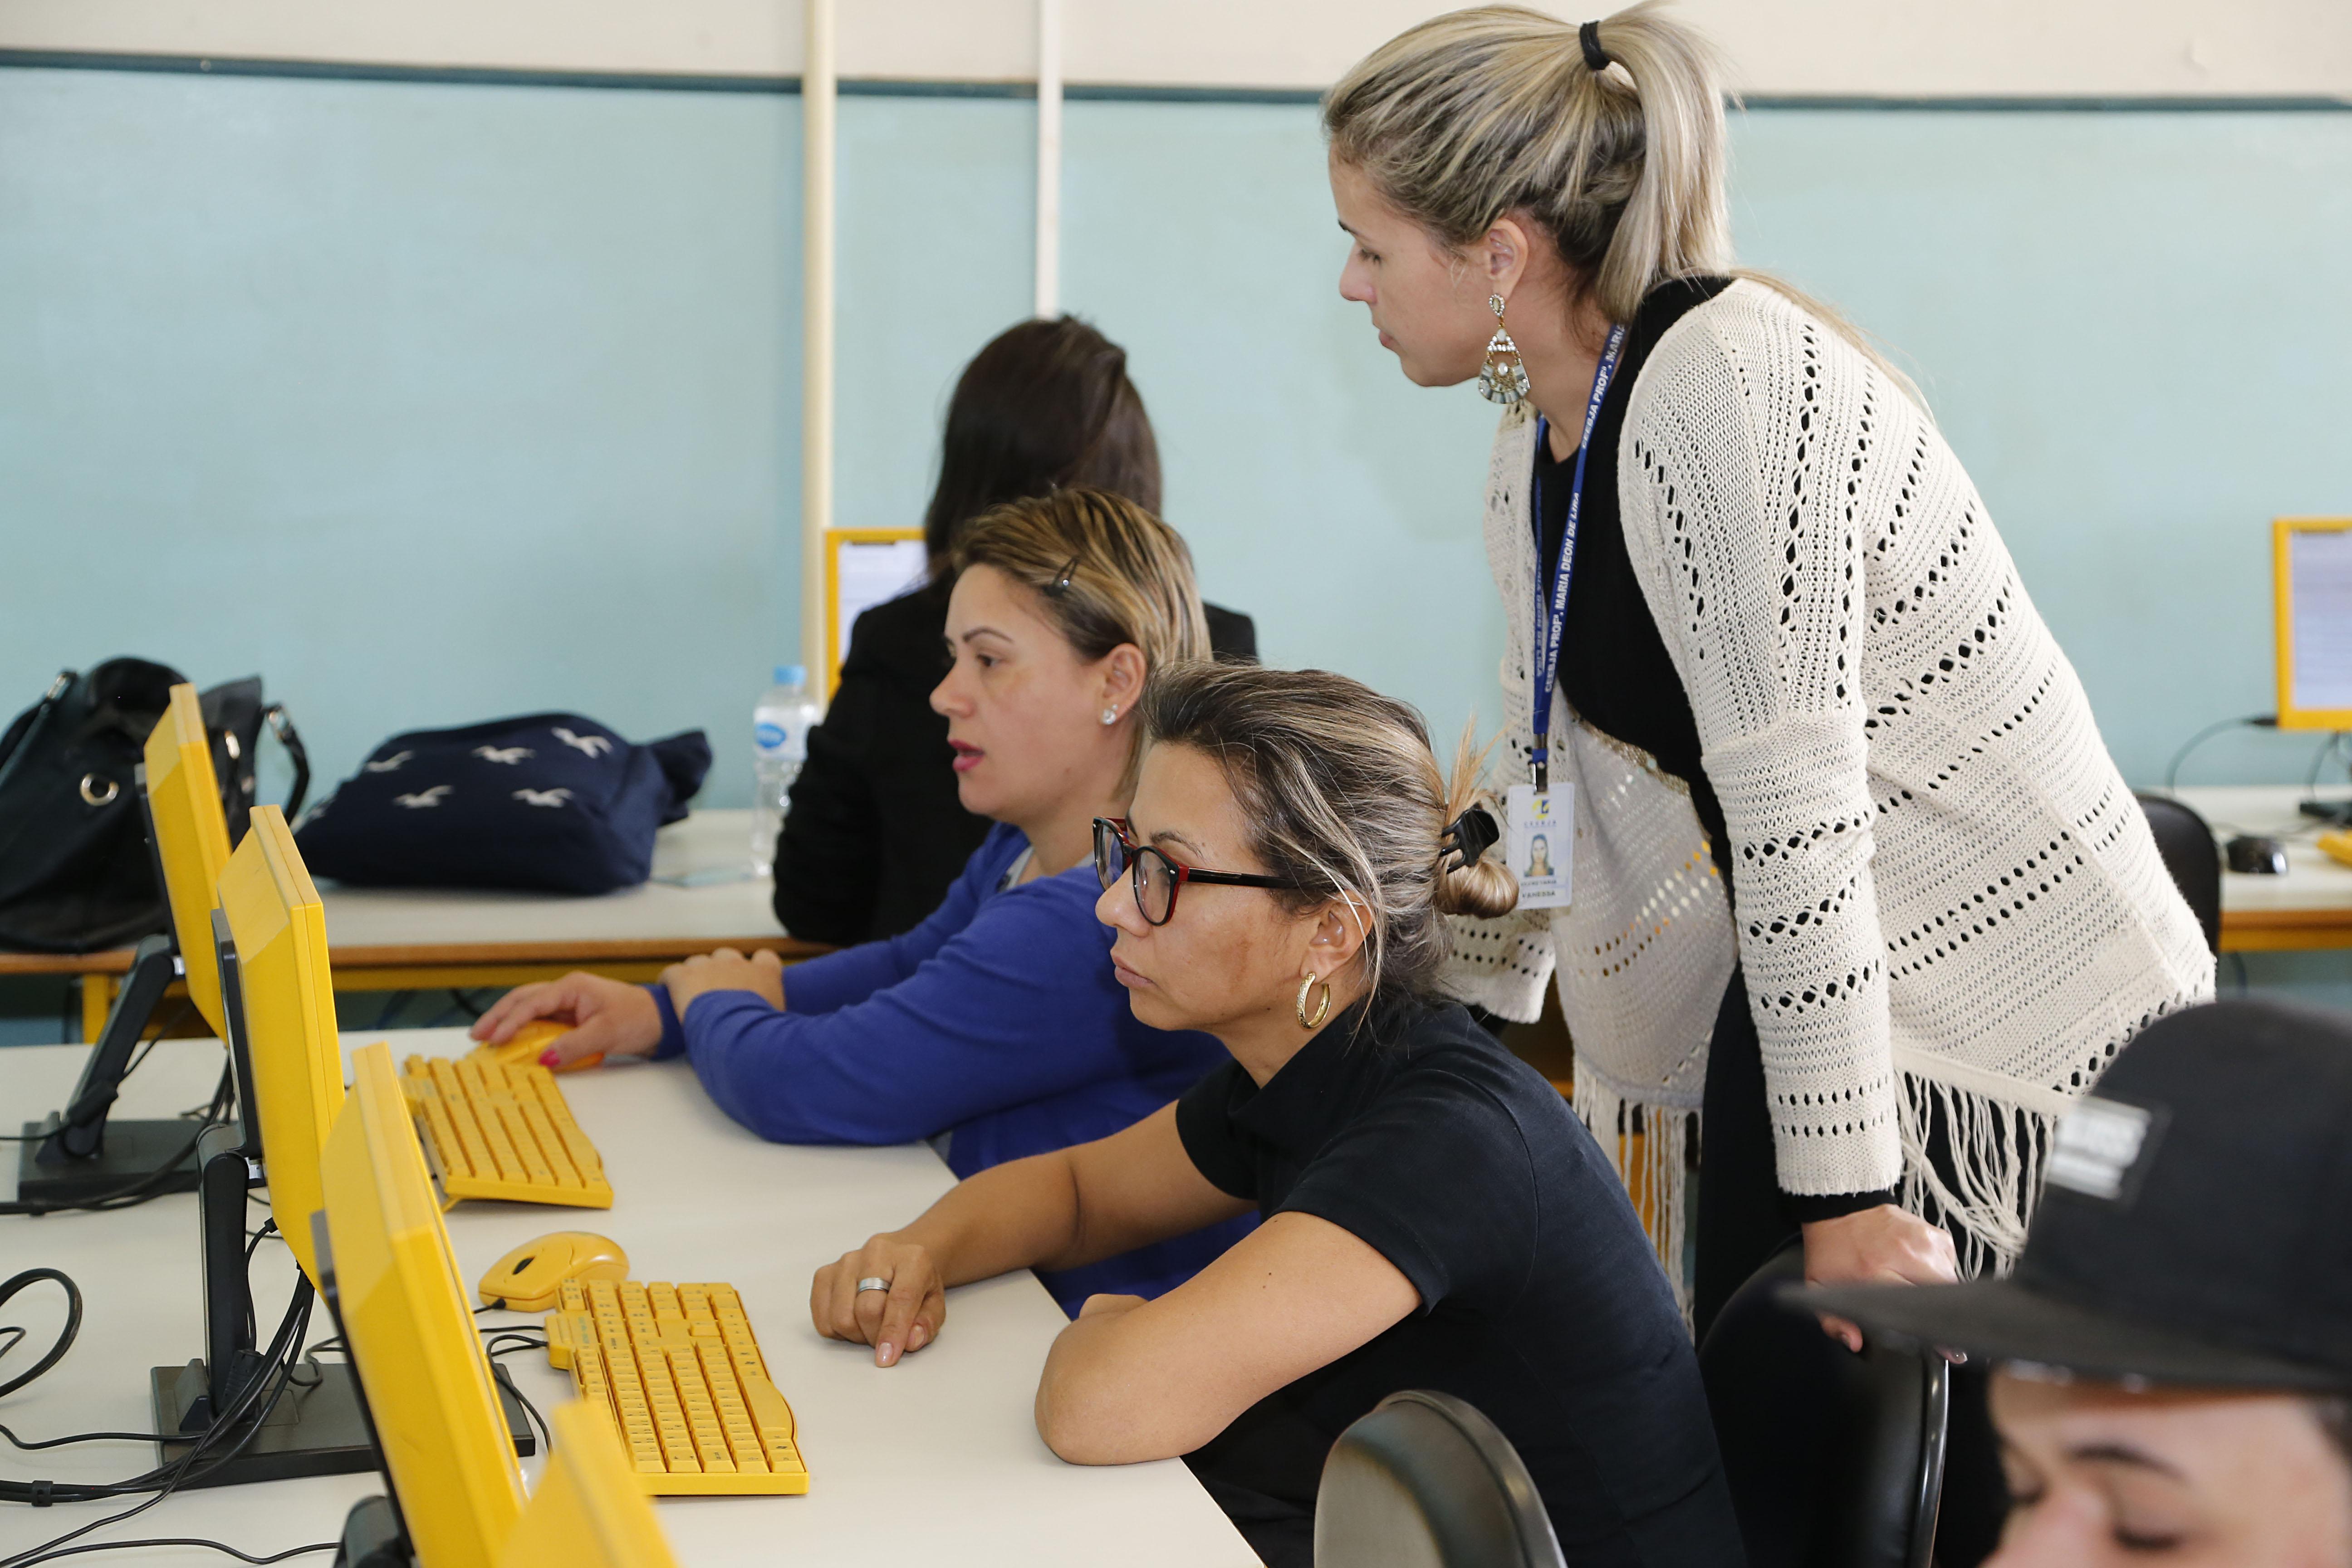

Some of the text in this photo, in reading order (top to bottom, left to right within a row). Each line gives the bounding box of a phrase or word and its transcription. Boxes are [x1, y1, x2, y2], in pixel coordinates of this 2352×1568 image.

[1571, 492, 1579, 519] LIRA
[1567, 520, 1576, 537] DE
[1561, 538, 1574, 571] DEON
[1555, 573, 1569, 610] MARIA
